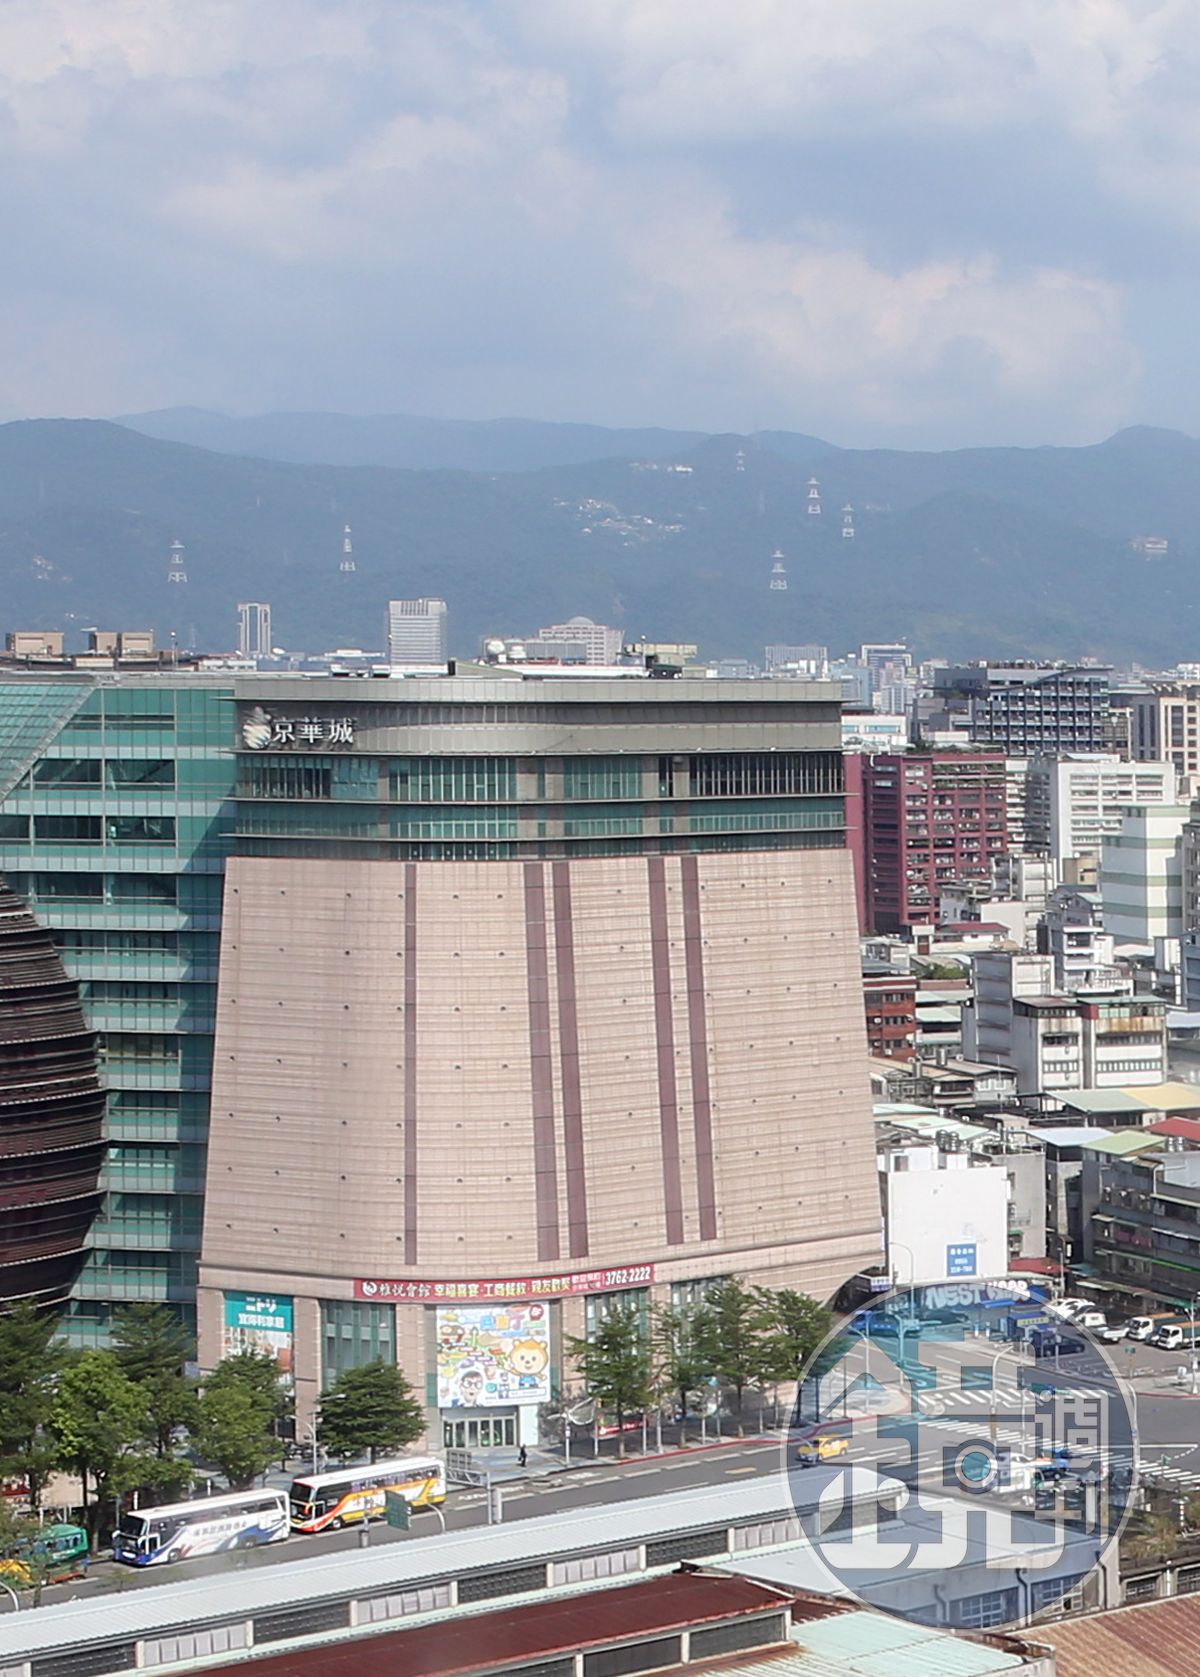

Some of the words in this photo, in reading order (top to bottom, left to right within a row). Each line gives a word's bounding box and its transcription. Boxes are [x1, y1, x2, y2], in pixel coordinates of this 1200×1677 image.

[273, 716, 353, 744] 京華城
[605, 1266, 651, 1286] 3762-2222
